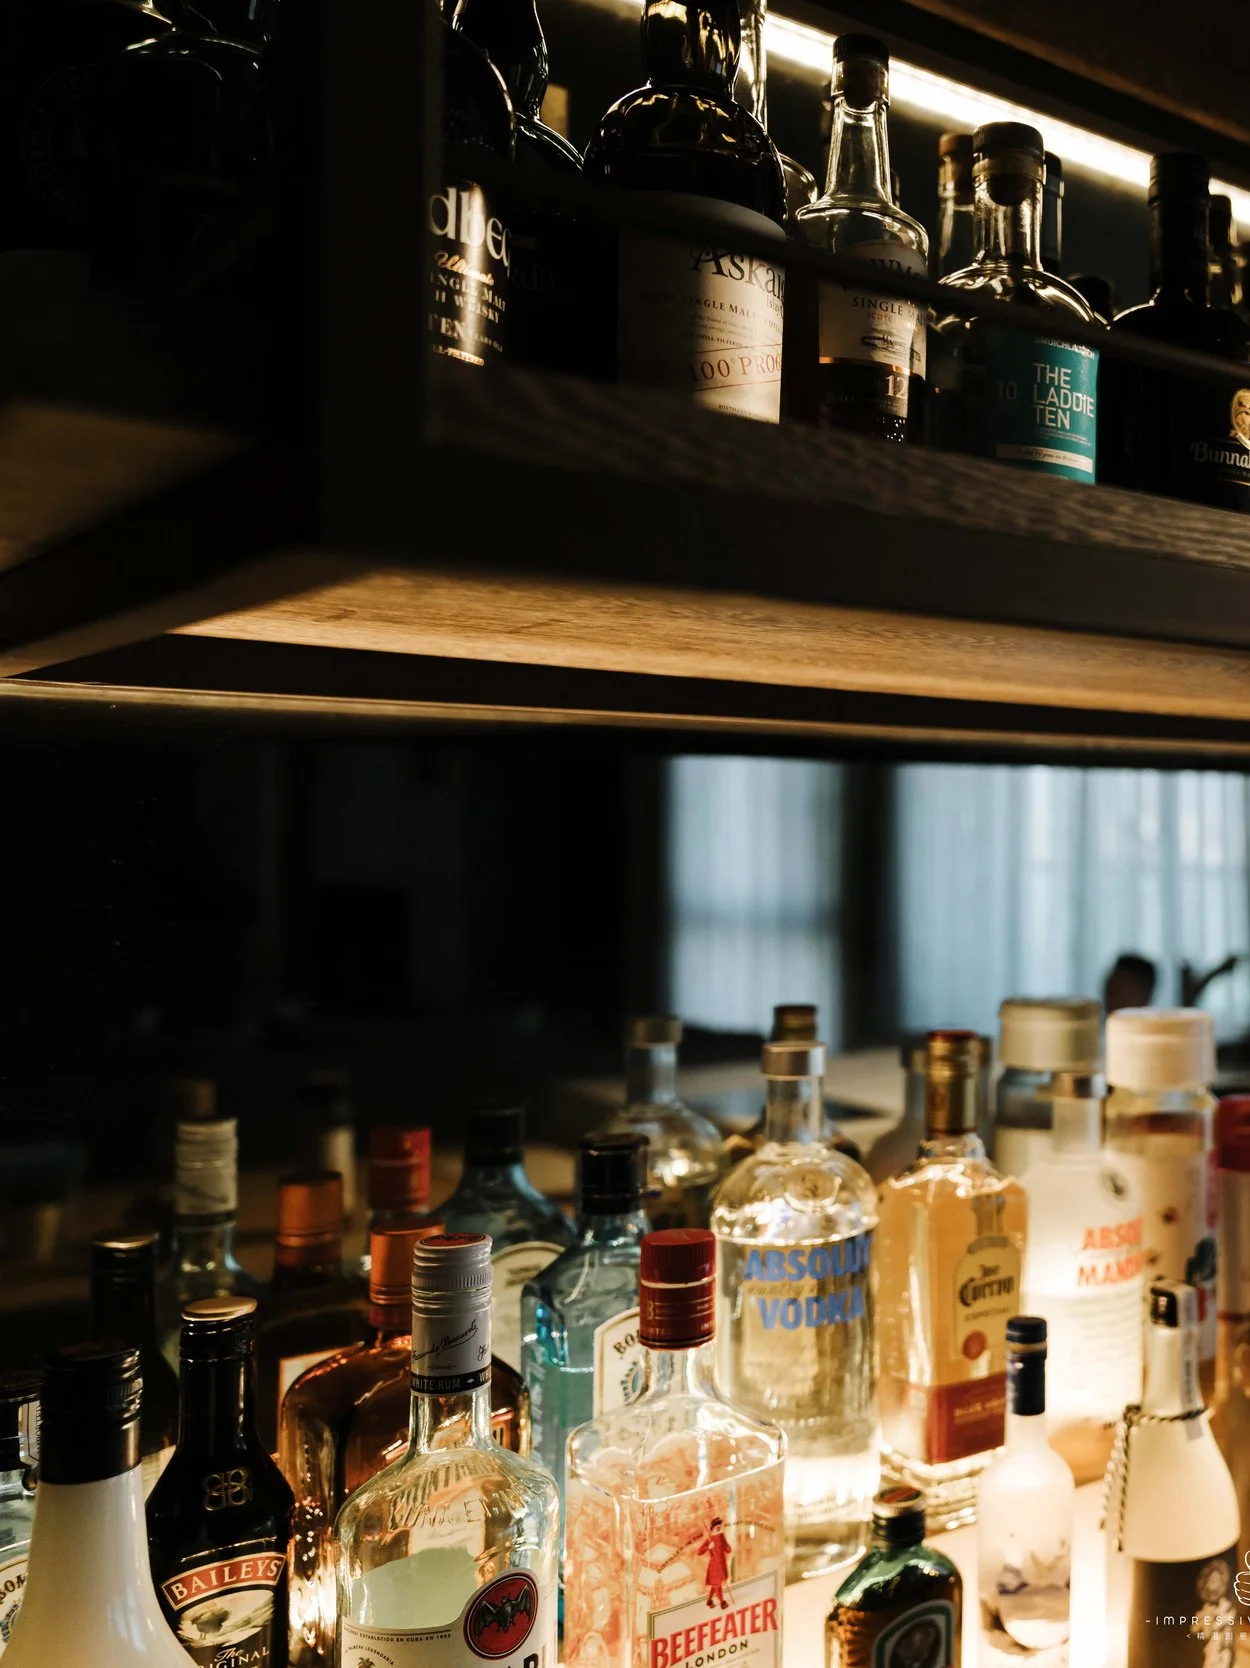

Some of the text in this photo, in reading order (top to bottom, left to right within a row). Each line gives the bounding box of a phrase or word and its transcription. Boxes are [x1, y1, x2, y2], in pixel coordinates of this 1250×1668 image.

[852, 297, 904, 316] SINGLE
[885, 374, 908, 399] 12
[1033, 362, 1072, 389] THE
[1034, 386, 1095, 418] LADDIE
[1031, 404, 1070, 430] TEN
[757, 1286, 865, 1331] VODKA
[438, 1376, 461, 1392] RUM
[170, 1559, 280, 1601] BAILEYS
[650, 1597, 779, 1668] BEEFEATER
[214, 1647, 245, 1662] The
